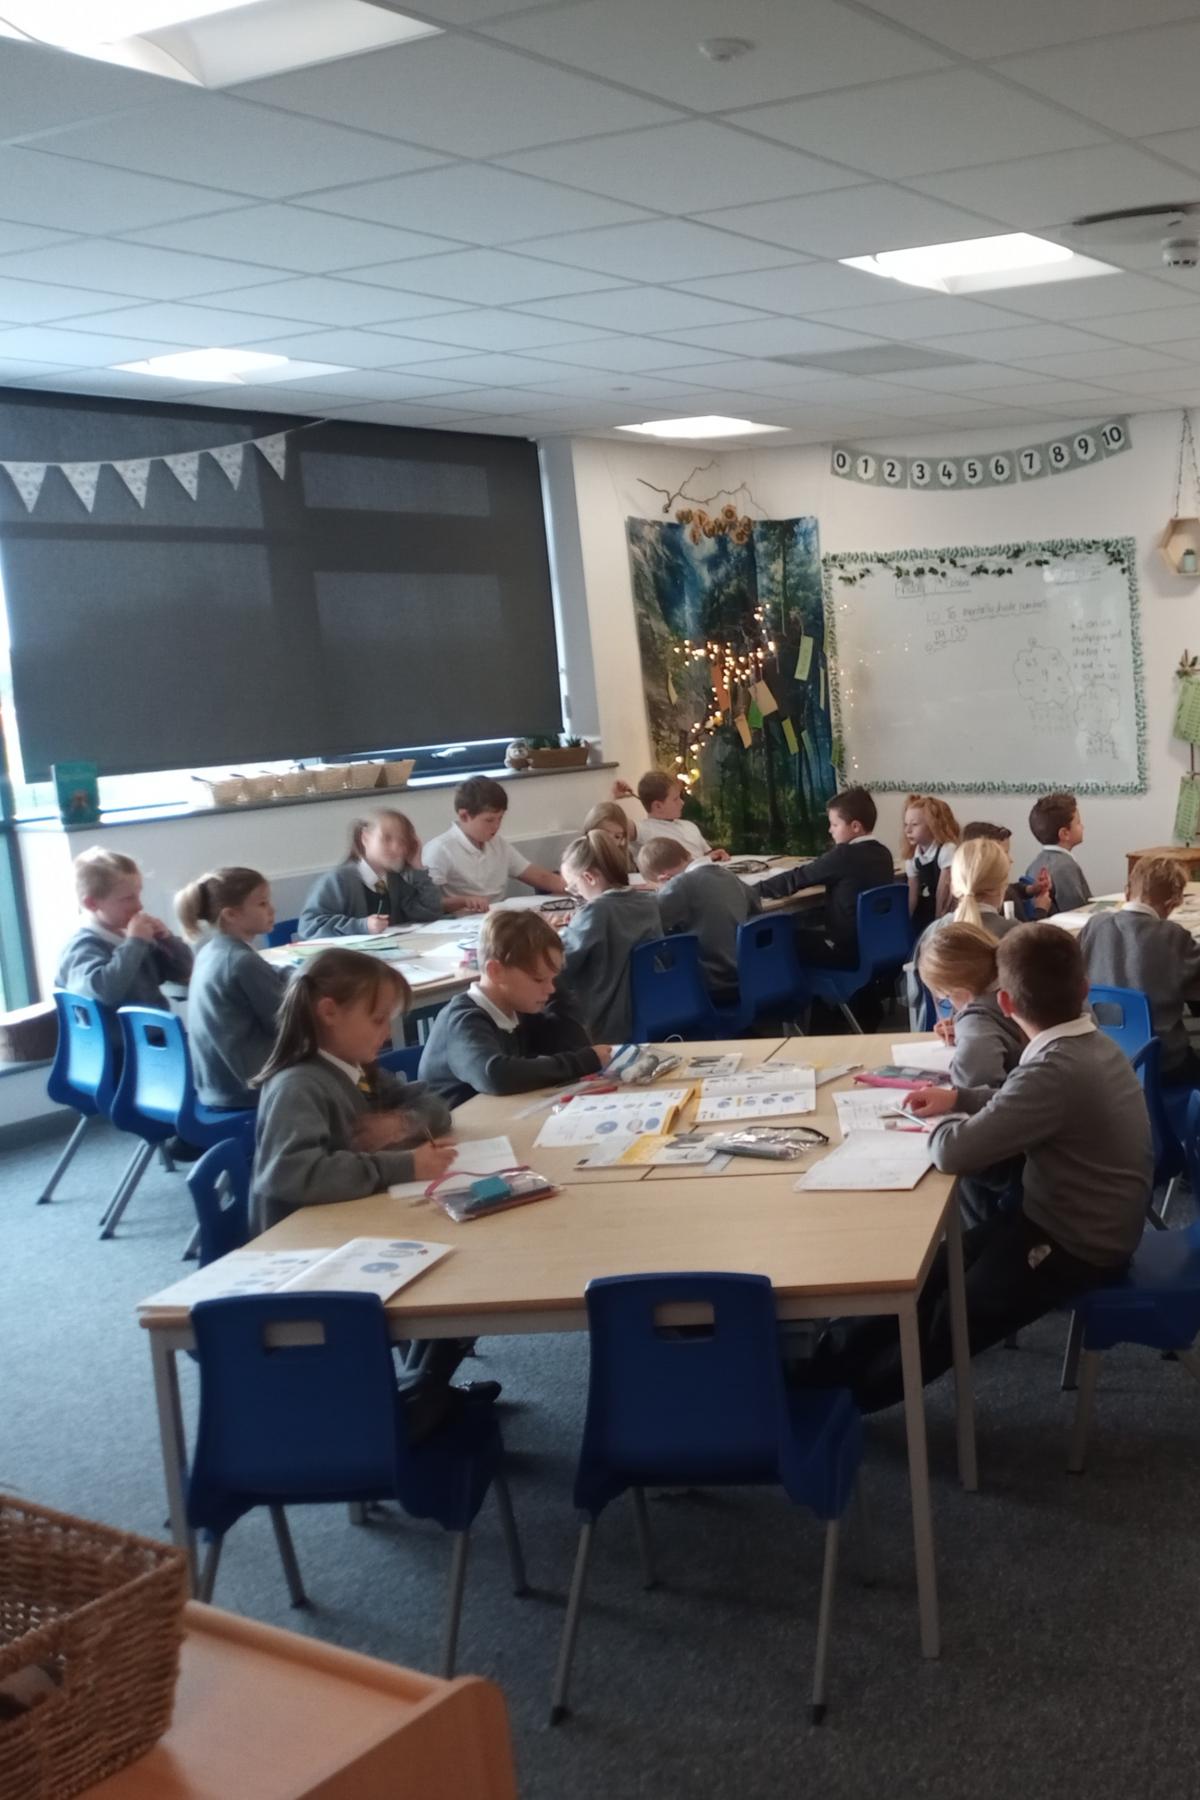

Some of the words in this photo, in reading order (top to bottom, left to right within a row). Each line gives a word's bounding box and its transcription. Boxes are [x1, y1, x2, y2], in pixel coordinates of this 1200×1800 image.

[835, 452, 847, 470] 0
[861, 458, 870, 473] 1
[885, 461, 898, 478] 2
[915, 463, 926, 480] 3
[941, 463, 953, 480] 4
[966, 462, 979, 479] 5
[993, 458, 1006, 476] 6
[1023, 452, 1036, 471] 7
[1052, 445, 1066, 464] 8
[1077, 437, 1090, 456] 9
[1101, 425, 1123, 447] 10
